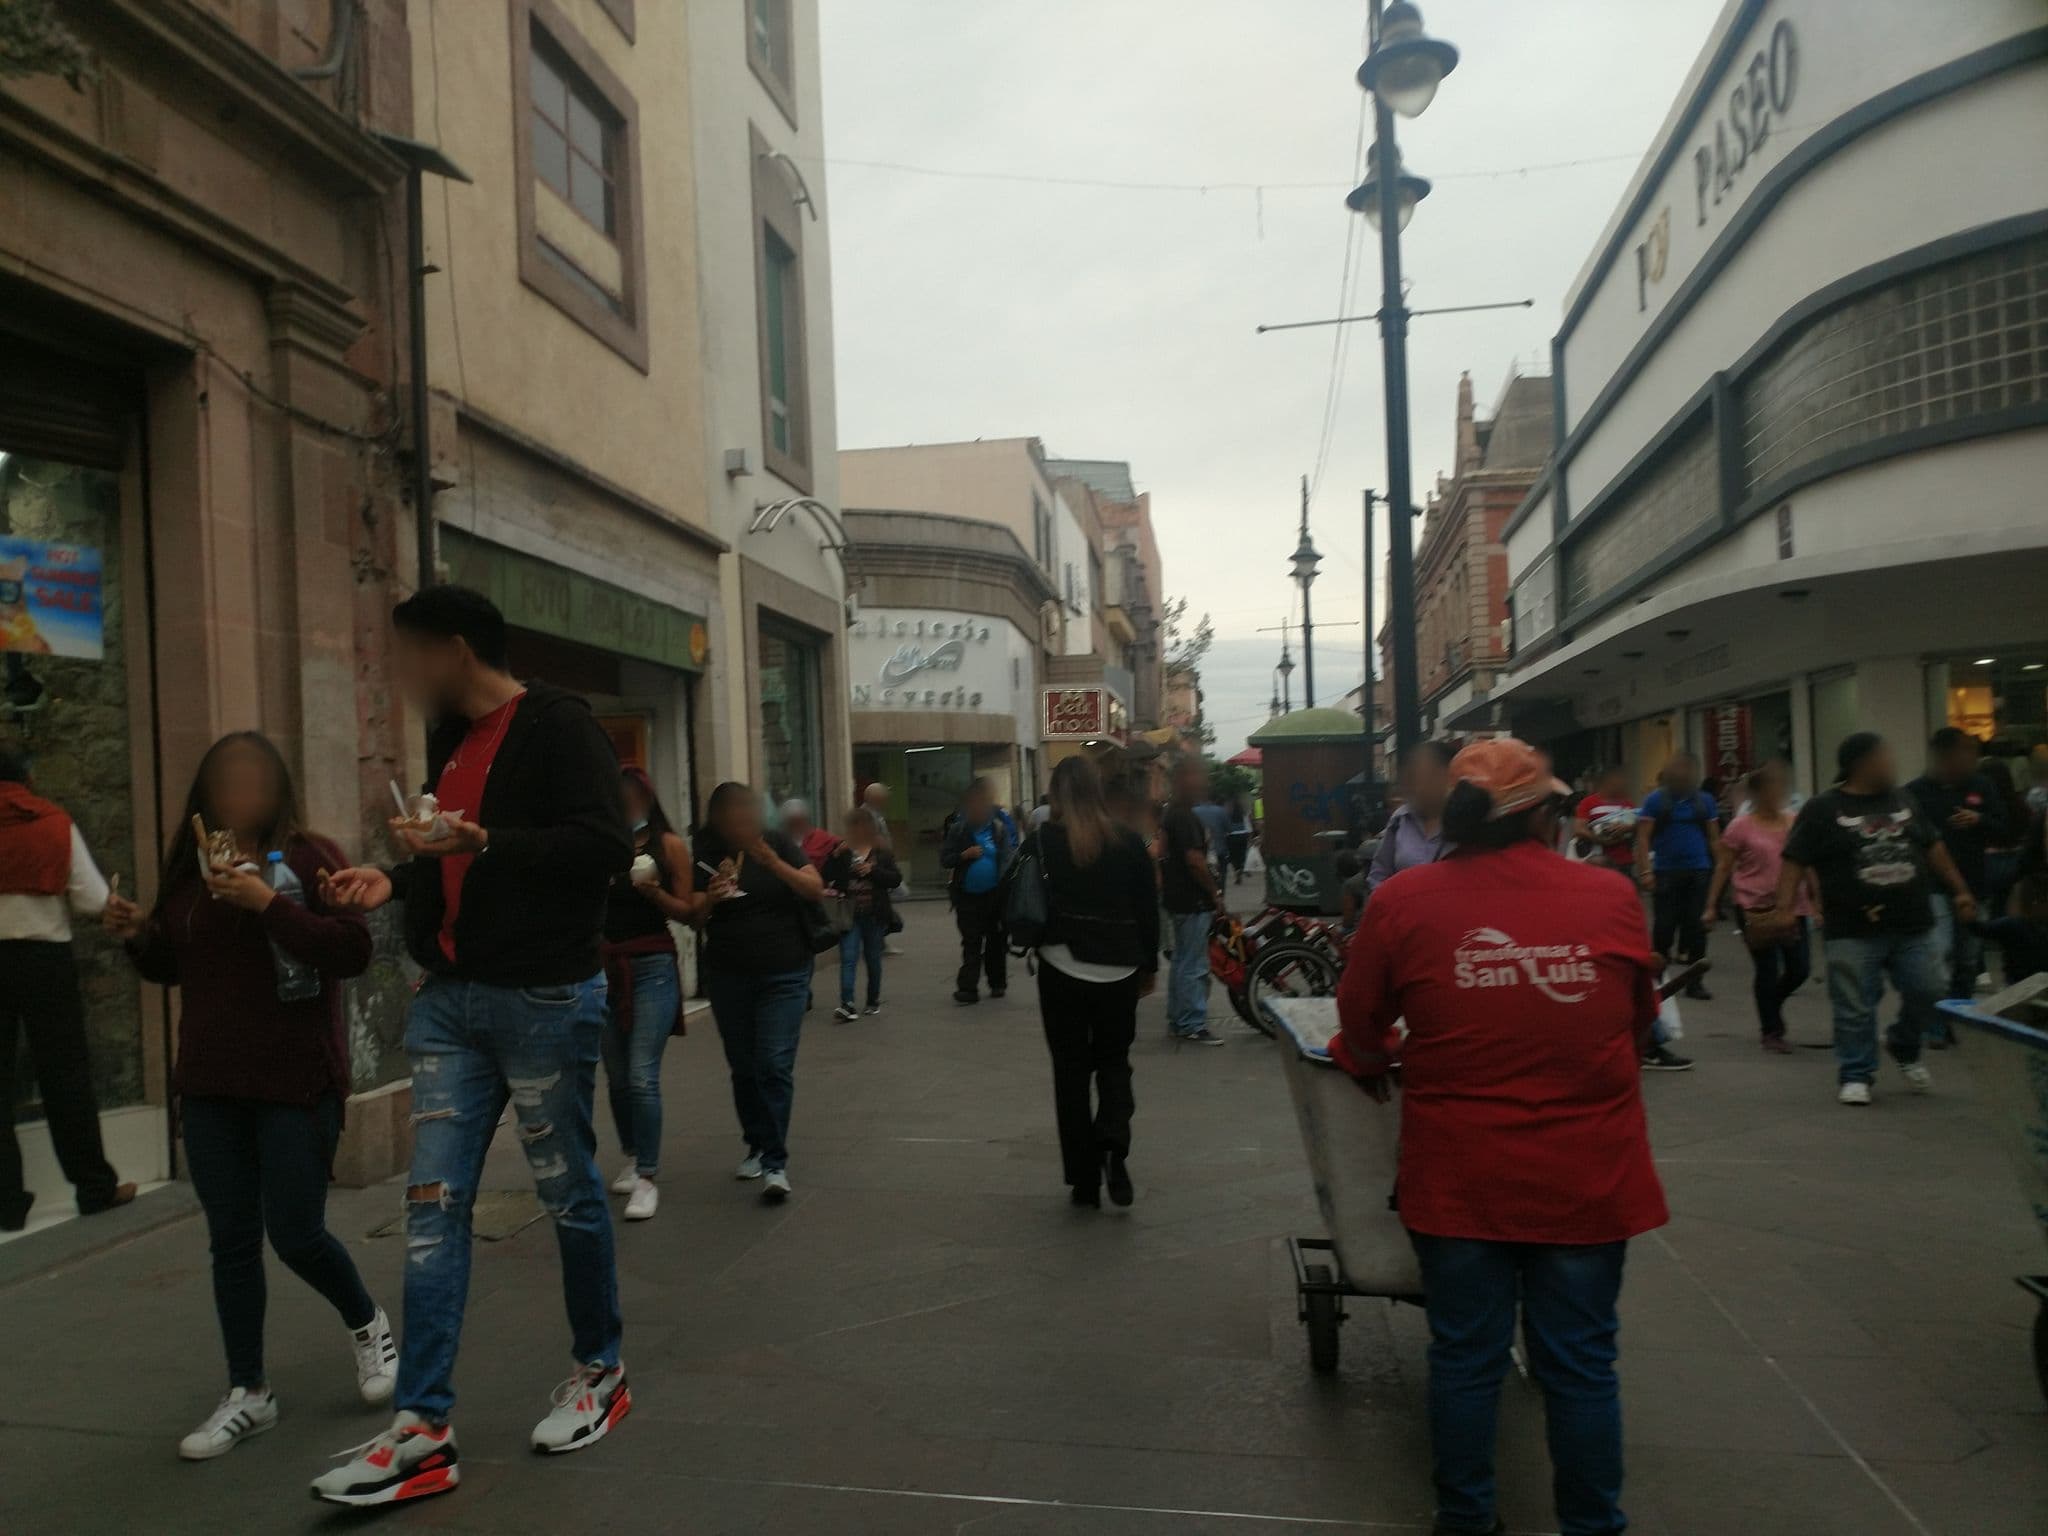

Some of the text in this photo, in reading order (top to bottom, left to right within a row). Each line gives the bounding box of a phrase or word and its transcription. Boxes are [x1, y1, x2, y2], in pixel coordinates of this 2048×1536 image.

[1693, 18, 1798, 228] PASEO
[36, 587, 92, 613] SALE
[1454, 957, 1597, 988] San Luis
